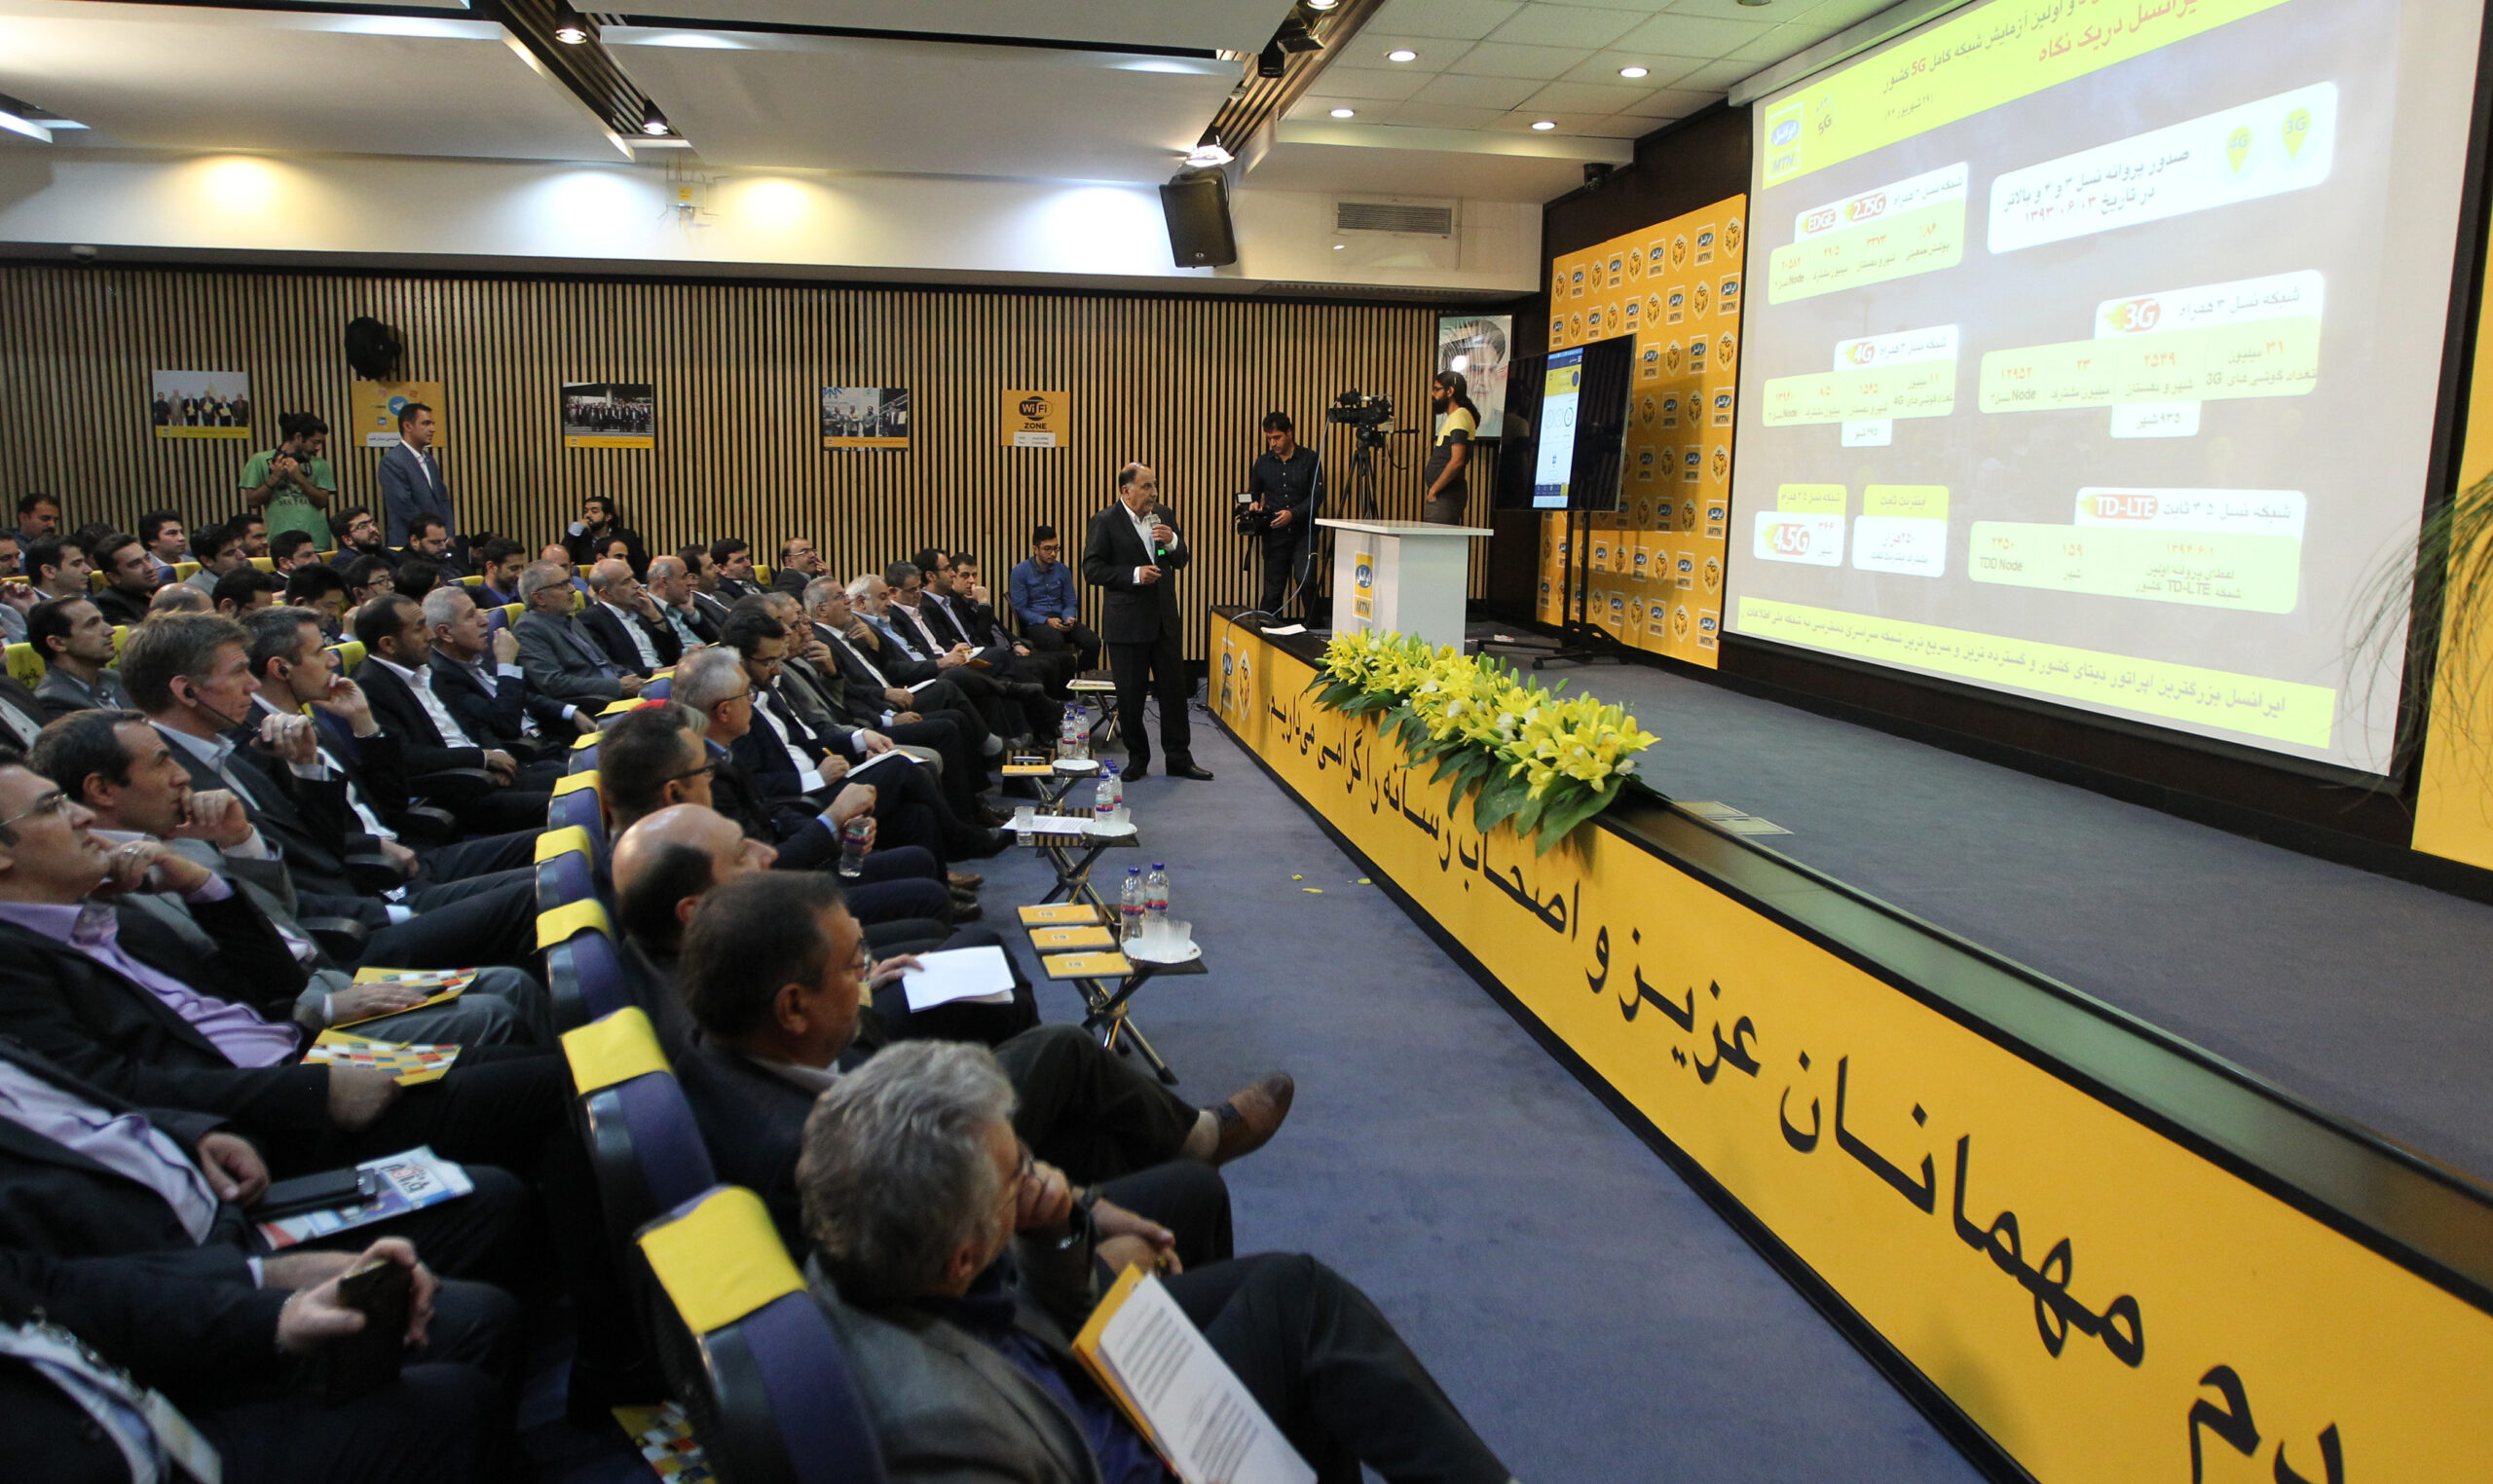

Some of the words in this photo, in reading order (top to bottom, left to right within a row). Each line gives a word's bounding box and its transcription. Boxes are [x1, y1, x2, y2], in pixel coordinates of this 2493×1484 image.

[2038, 32, 2072, 61] نگاه
[1911, 56, 1926, 76] 5G
[1817, 113, 1832, 134] 5G
[2281, 116, 2306, 139] 3G
[2226, 132, 2250, 154] 4G
[2148, 150, 2189, 175] صدور
[2075, 174, 2102, 192] نسل
[2100, 187, 2136, 215] تاریخ
[1807, 208, 1836, 233] EDGE
[2229, 294, 2259, 314] نسل
[2262, 286, 2299, 305] شبکه
[2123, 297, 2160, 332] 3G
[1852, 341, 1874, 365] 4G
[2205, 371, 2222, 386] 3G
[2093, 493, 2156, 520] TD-LTE
[2166, 578, 2211, 596] TD-LTE
[2038, 660, 2069, 675] کشور
[2224, 688, 2286, 719] ایرانسل
[1317, 729, 1362, 794] گرامی
[1366, 745, 1379, 815] را
[1383, 762, 1450, 872] رسانه
[1459, 831, 1580, 942] اصحاب
[1584, 924, 1610, 994] و
[1619, 927, 1761, 1085] عزیز
[1779, 1050, 2144, 1368] مهمانان
